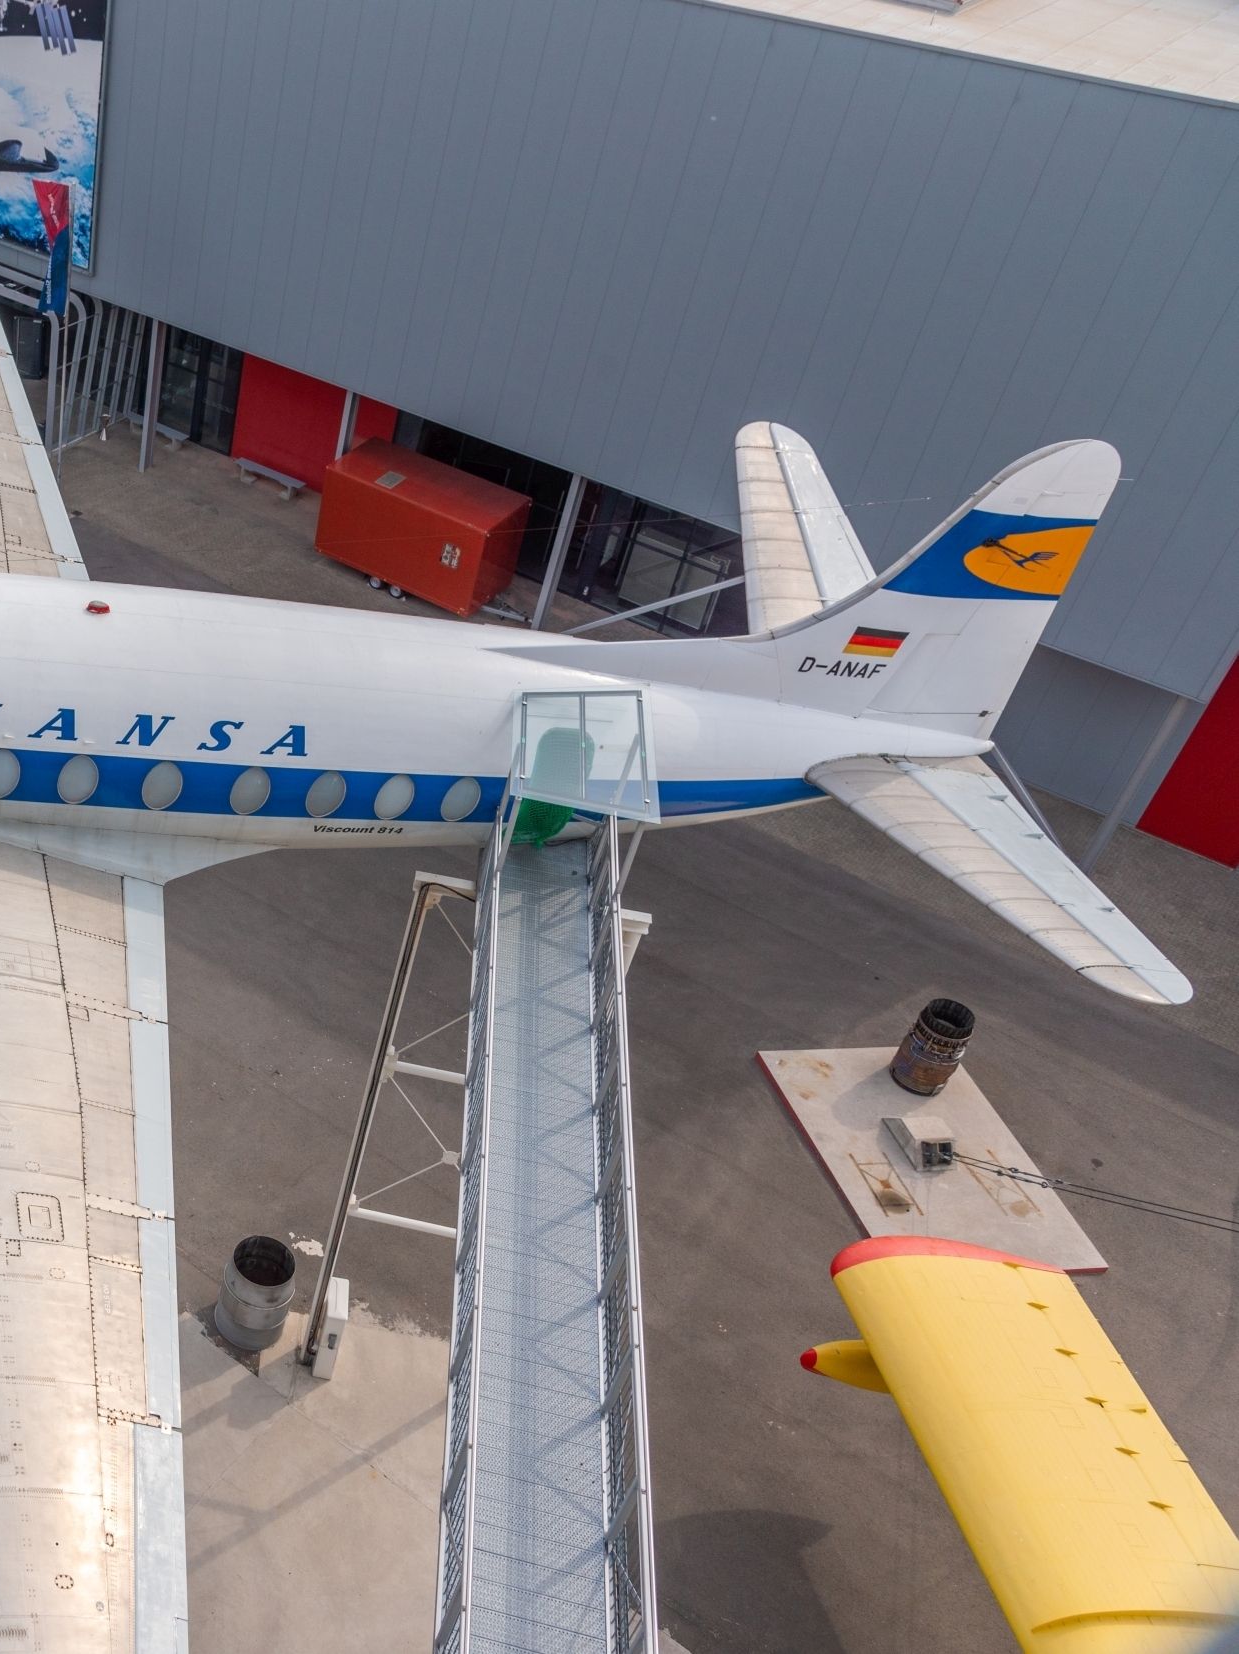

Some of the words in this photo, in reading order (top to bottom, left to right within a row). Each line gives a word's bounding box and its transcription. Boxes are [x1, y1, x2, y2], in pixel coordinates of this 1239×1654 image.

[798, 656, 887, 679] D-ANAF
[313, 825, 375, 835] Viscount
[377, 827, 404, 835] 814
